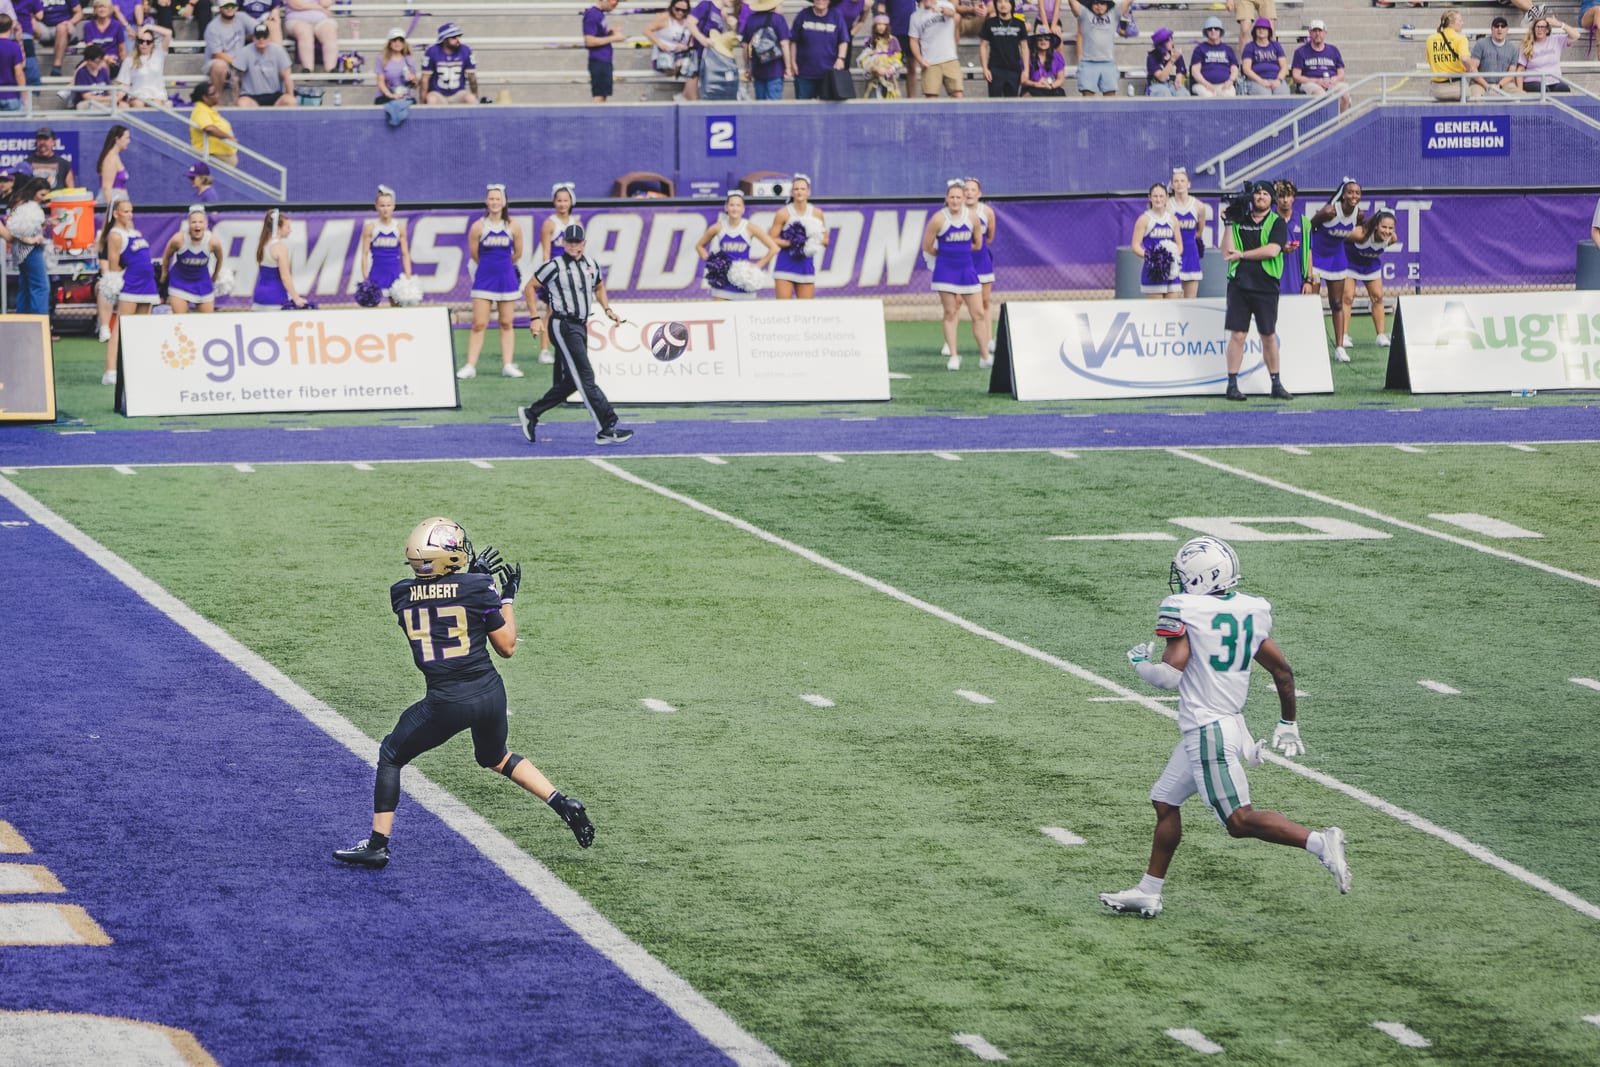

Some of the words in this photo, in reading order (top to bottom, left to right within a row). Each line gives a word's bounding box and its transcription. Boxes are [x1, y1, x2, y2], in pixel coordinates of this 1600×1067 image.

[709, 121, 734, 150] 2
[1434, 120, 1498, 134] GENERAL
[0, 138, 66, 151] GENEL
[1427, 136, 1505, 149] ADMISSION
[1179, 219, 1197, 230] MU
[151, 215, 470, 298] AMS
[495, 208, 929, 292] ADON
[750, 315, 791, 325] Trusted
[794, 313, 842, 325] Partners
[202, 324, 280, 383] glo
[284, 320, 414, 365] fiber
[751, 348, 819, 360] Empowered
[821, 347, 862, 359] People
[598, 361, 725, 376] NSURANCE
[180, 389, 236, 404] Faster,
[241, 387, 293, 401] better
[299, 385, 338, 399] fiber
[343, 384, 414, 397] internet.
[409, 583, 459, 602] HALBERT
[403, 605, 471, 662] 43
[1209, 612, 1254, 672] 31
